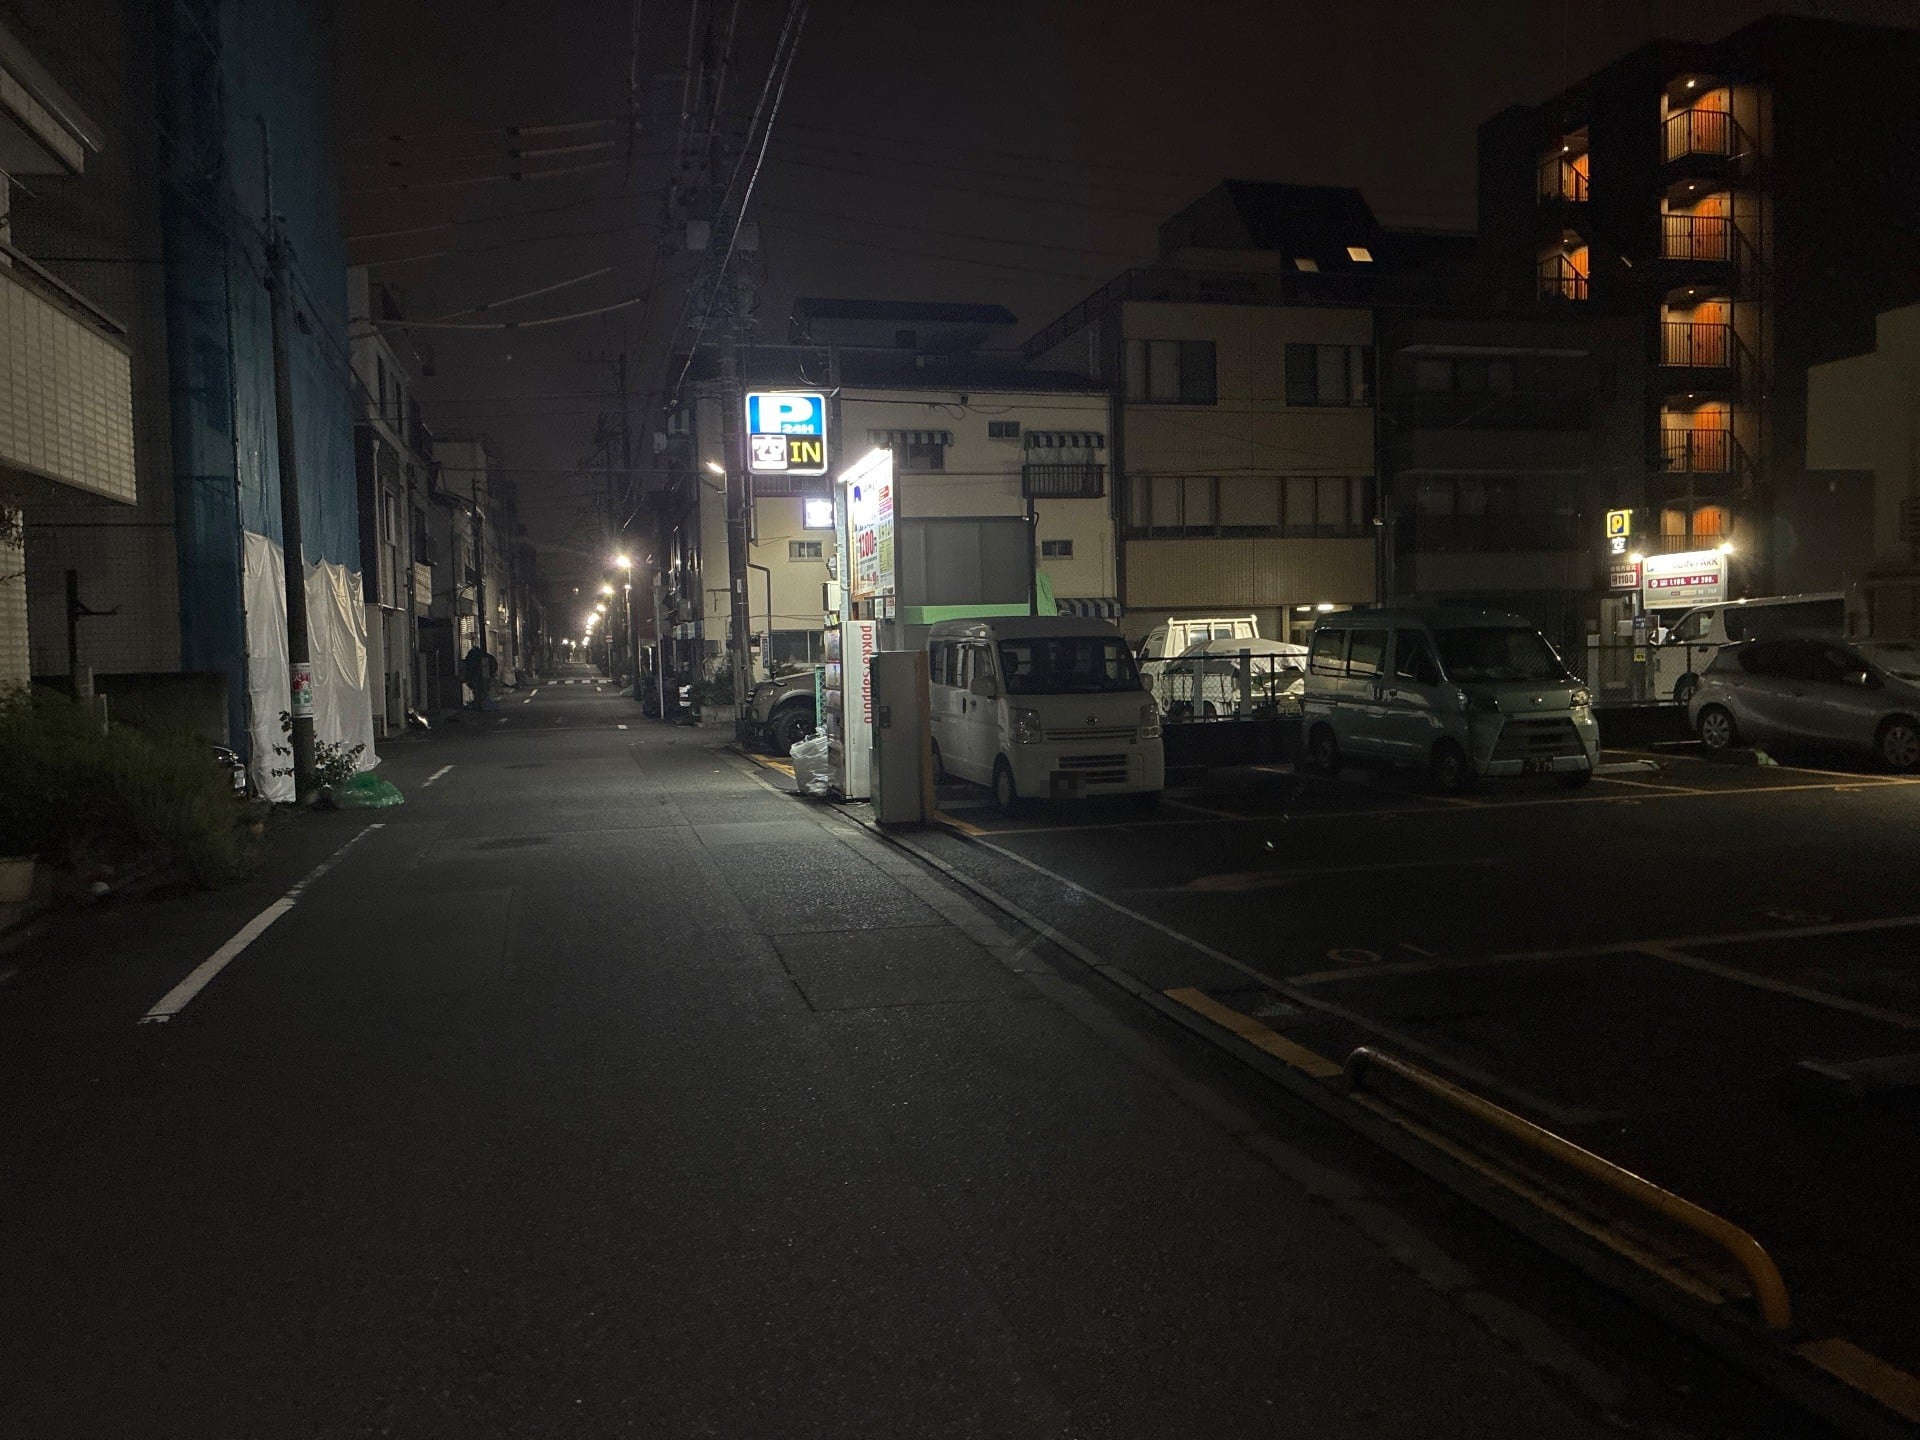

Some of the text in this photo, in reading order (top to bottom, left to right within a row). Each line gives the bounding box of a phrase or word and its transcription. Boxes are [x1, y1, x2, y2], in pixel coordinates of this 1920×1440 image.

[758, 395, 814, 433] P
[790, 441, 821, 462] IN
[1611, 515, 1623, 533] P
